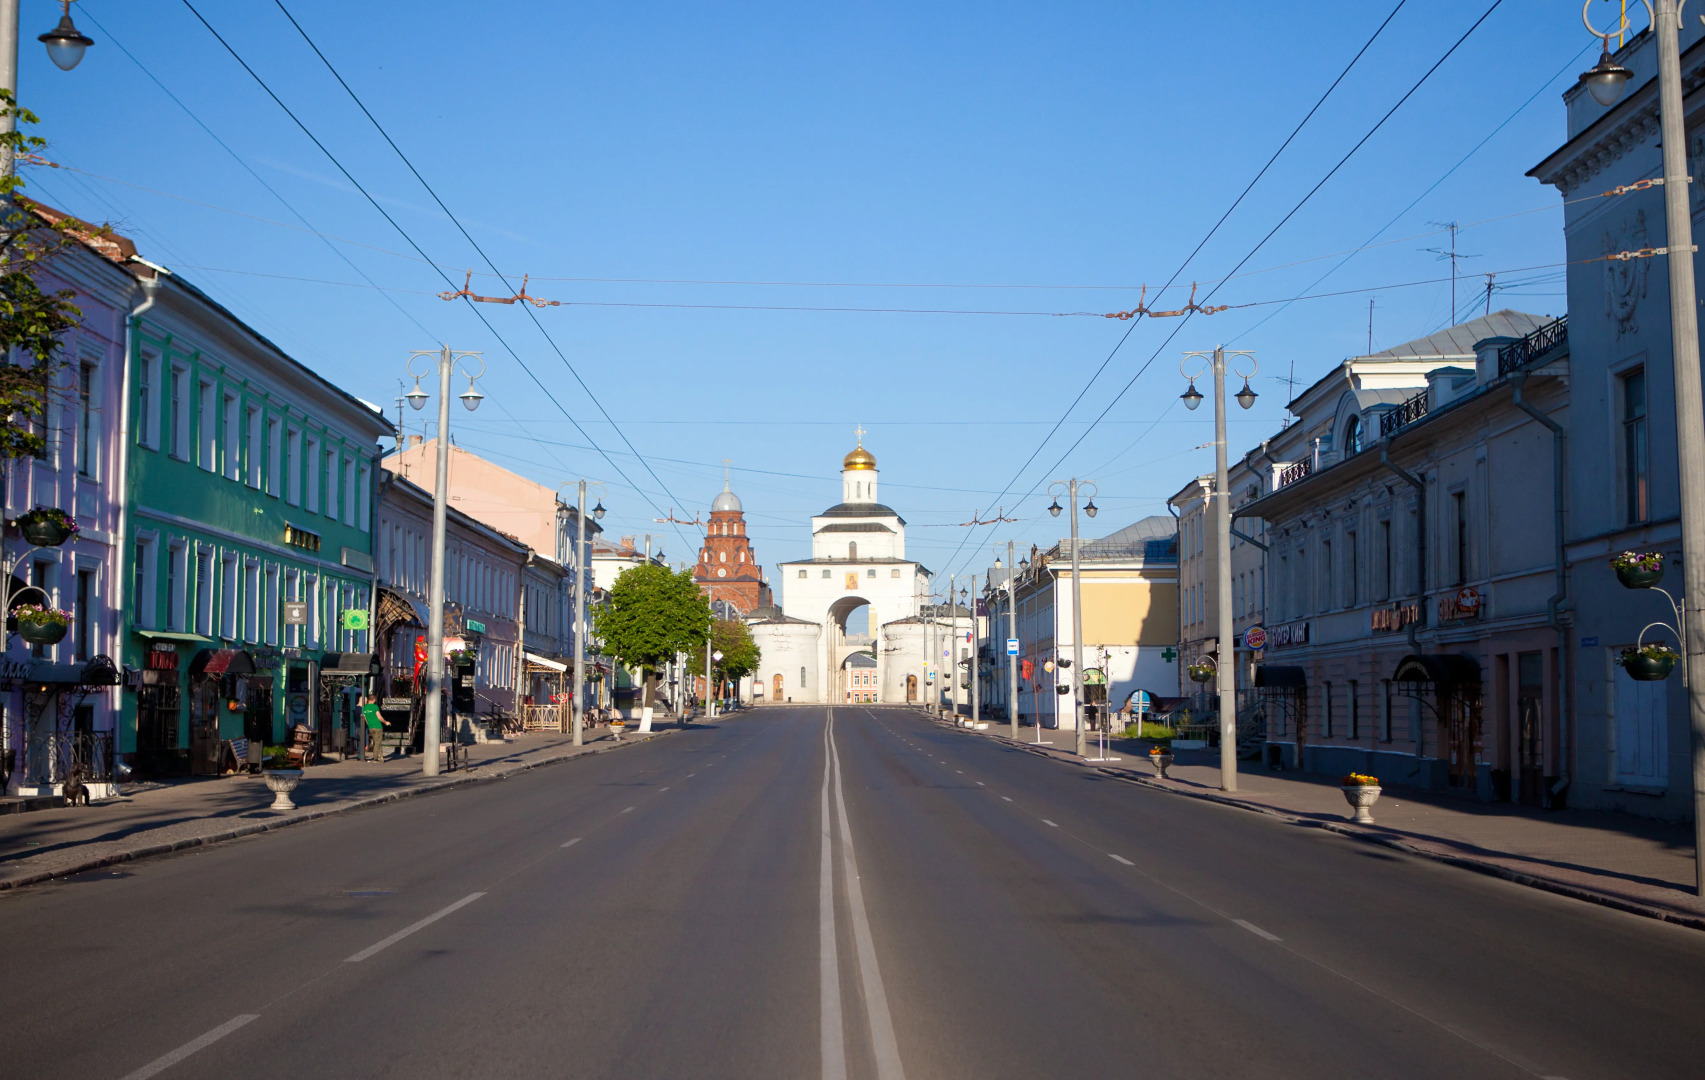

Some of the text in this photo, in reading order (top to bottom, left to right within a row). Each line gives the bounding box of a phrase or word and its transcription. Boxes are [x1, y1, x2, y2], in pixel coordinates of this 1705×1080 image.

[1247, 634, 1266, 645] KING
[1272, 623, 1306, 646] БУРГЕР КИНГ
